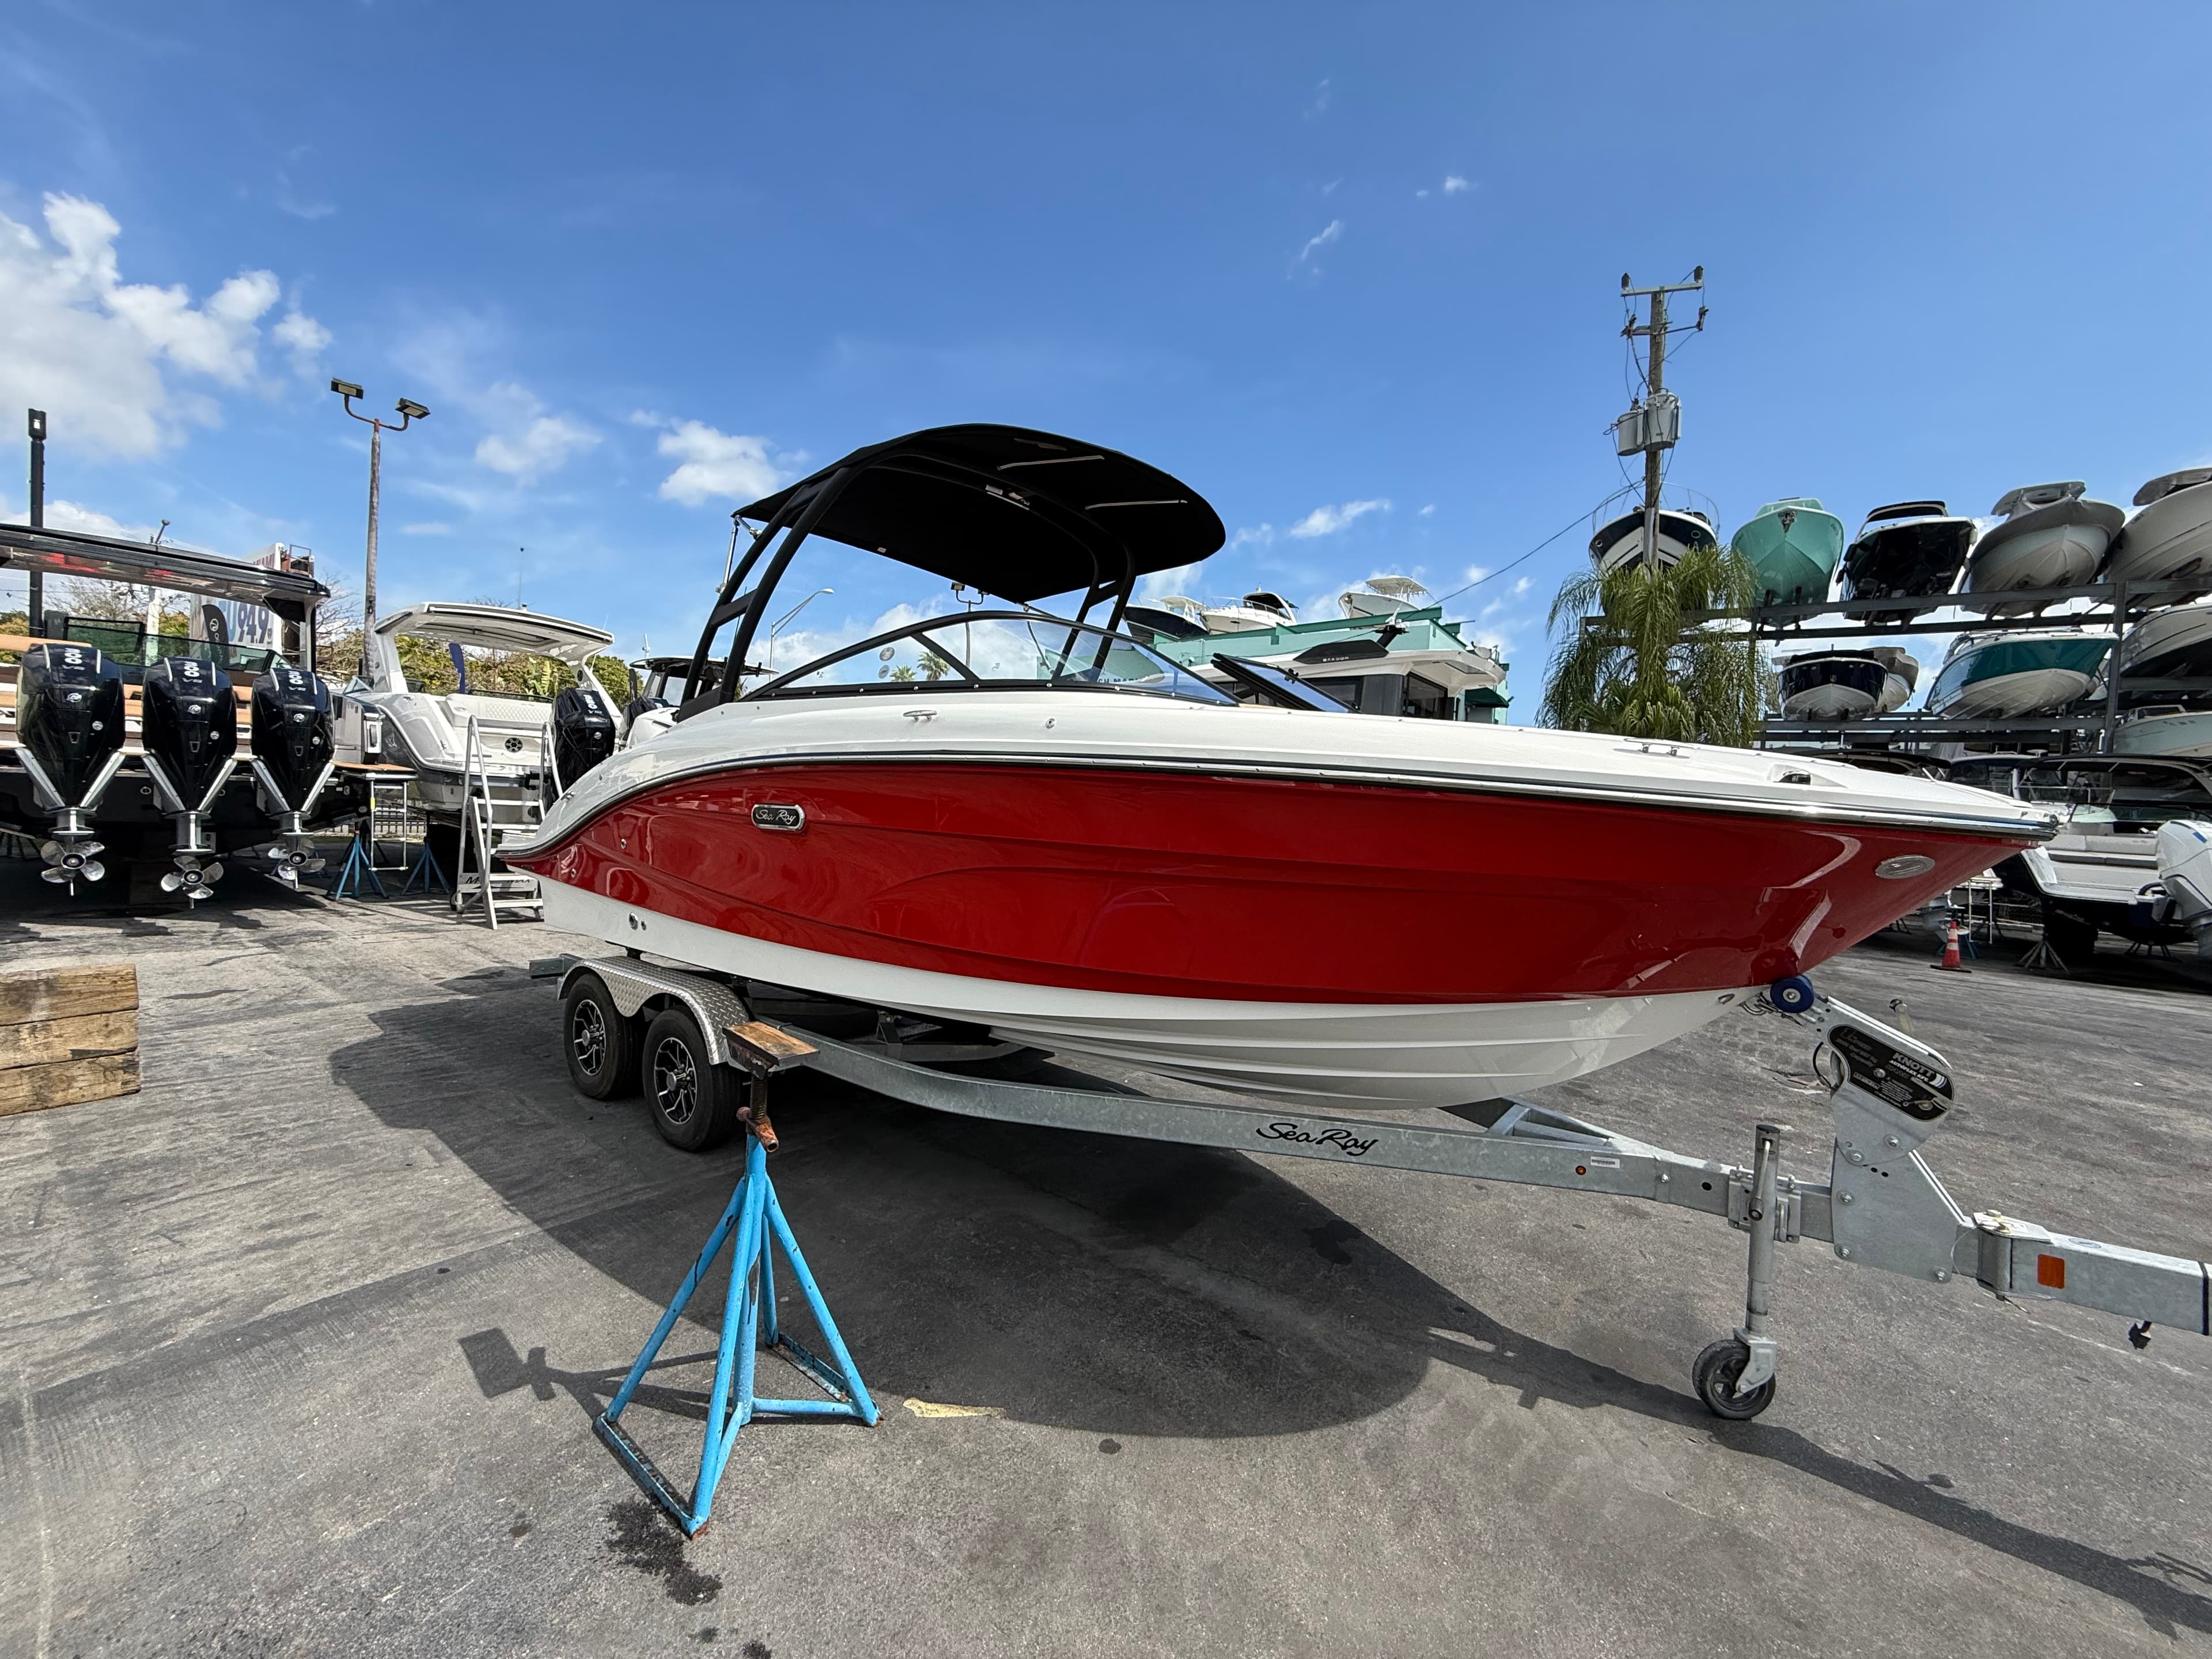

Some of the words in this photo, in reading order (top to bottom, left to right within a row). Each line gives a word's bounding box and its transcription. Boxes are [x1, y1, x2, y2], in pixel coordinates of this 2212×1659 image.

[755, 809, 775, 821] Sea
[775, 809, 797, 825] Ray
[1892, 1052, 1937, 1078] KNOTT
[1256, 1123, 1318, 1143] Sea
[1315, 1128, 1379, 1157] Ray
